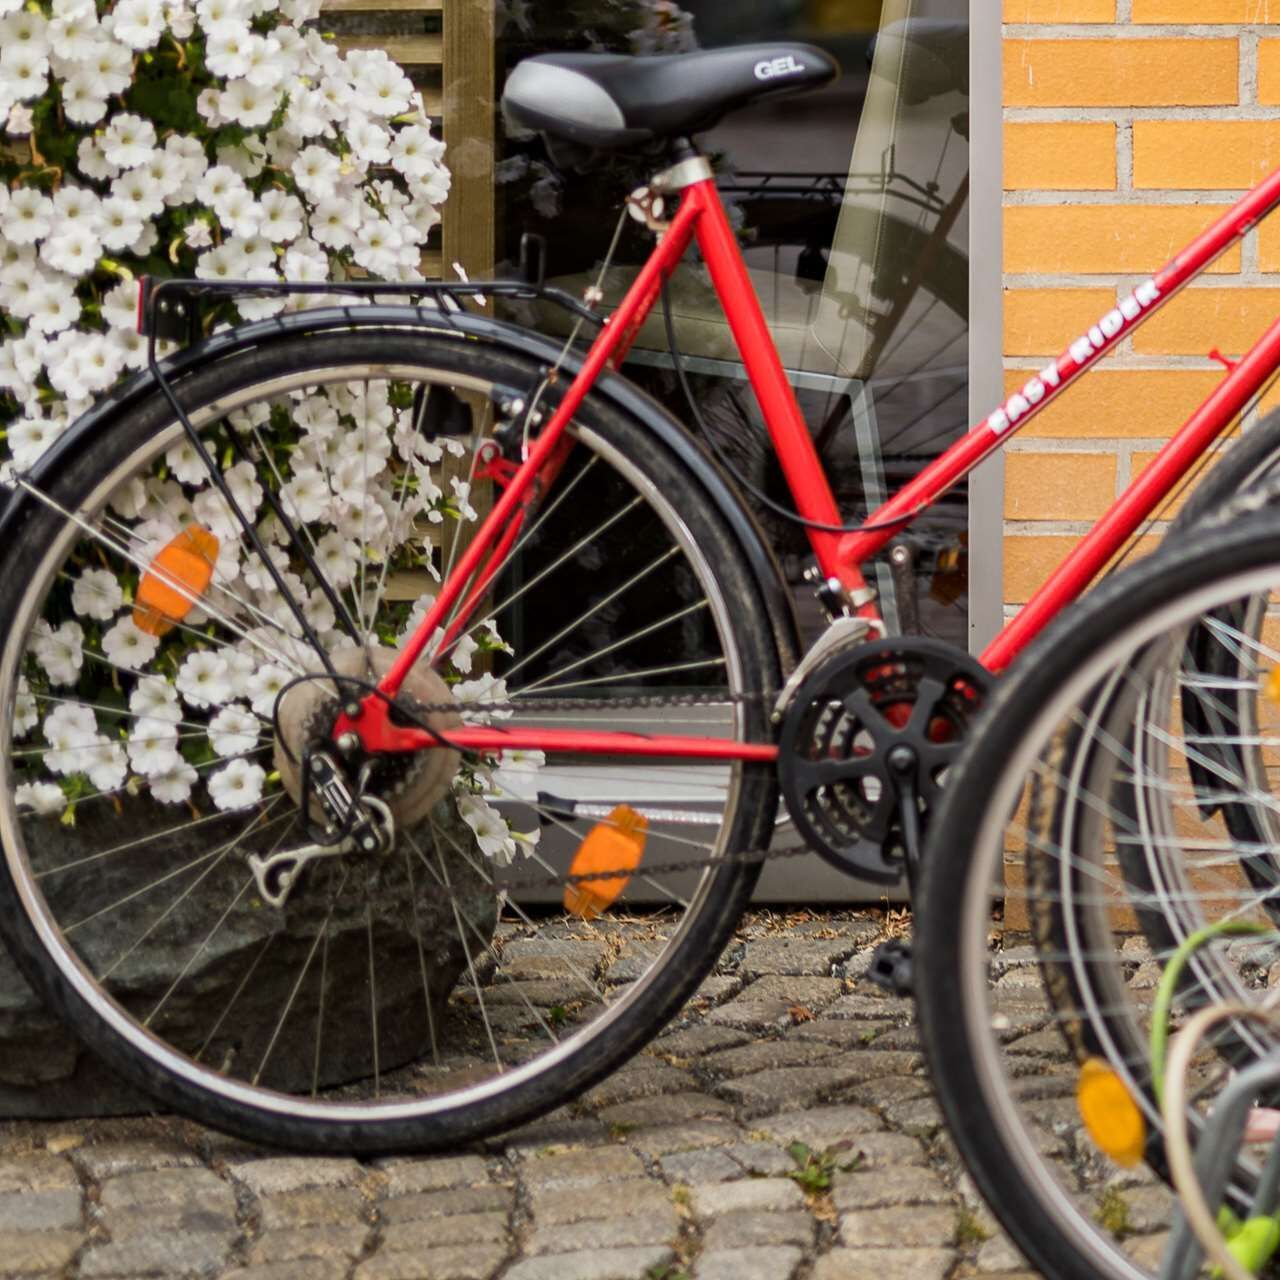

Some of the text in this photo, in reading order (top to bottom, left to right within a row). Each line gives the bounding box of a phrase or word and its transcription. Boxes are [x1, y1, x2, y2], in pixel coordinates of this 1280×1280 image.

[753, 55, 806, 81] GEL
[988, 280, 1160, 435] EASY RIDER
